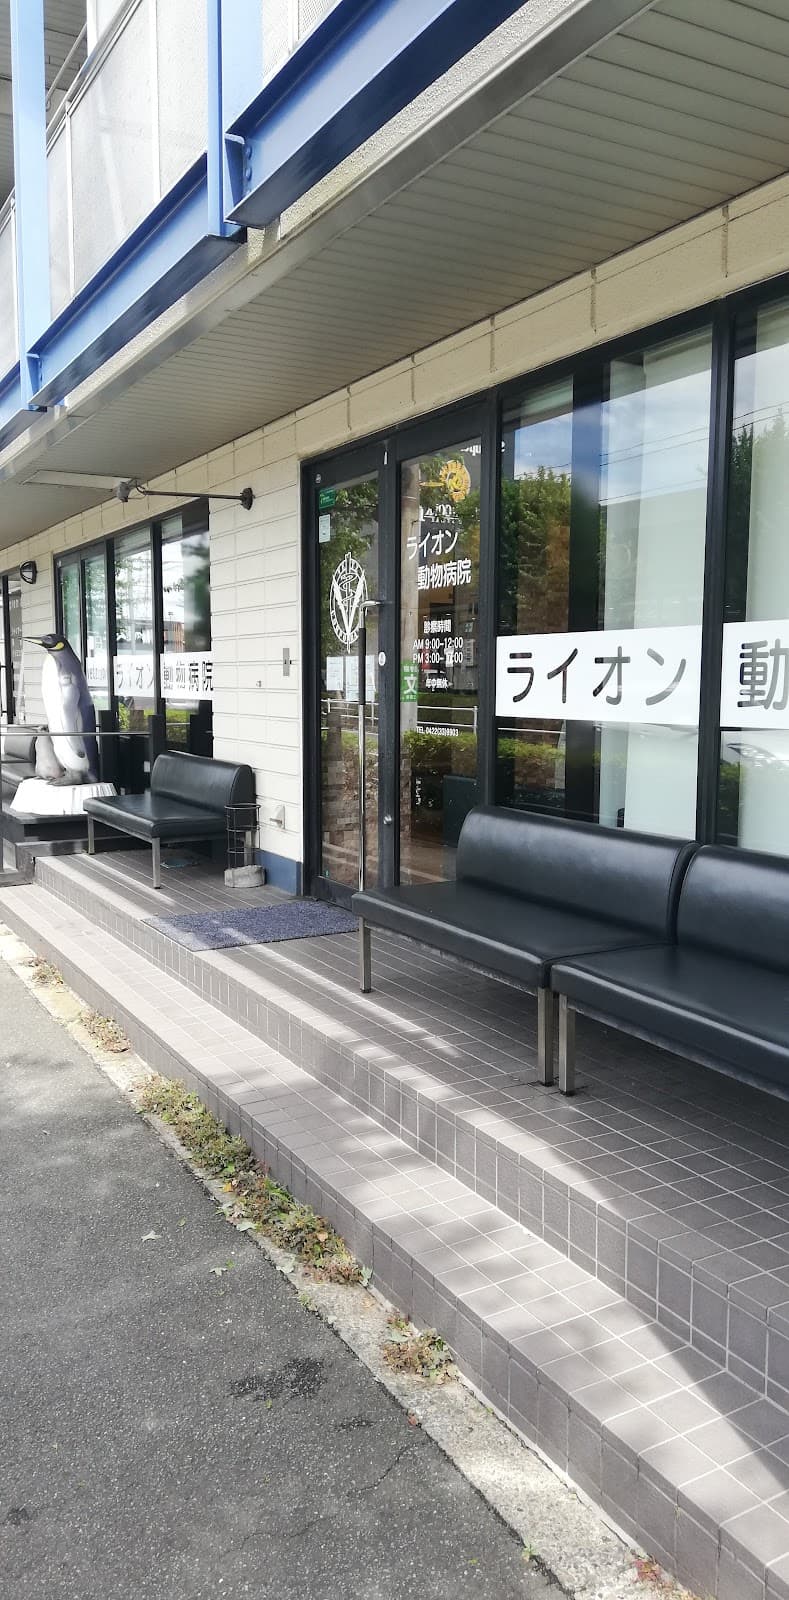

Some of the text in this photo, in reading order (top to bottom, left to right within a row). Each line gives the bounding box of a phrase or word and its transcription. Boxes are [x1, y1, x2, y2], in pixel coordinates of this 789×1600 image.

[406, 529, 459, 561] ライオン
[416, 557, 473, 591] 動物病院
[412, 638, 424, 650] AM
[412, 652, 424, 664] PM
[163, 660, 214, 692] 動物病院
[507, 638, 789, 711] ライオン 動
